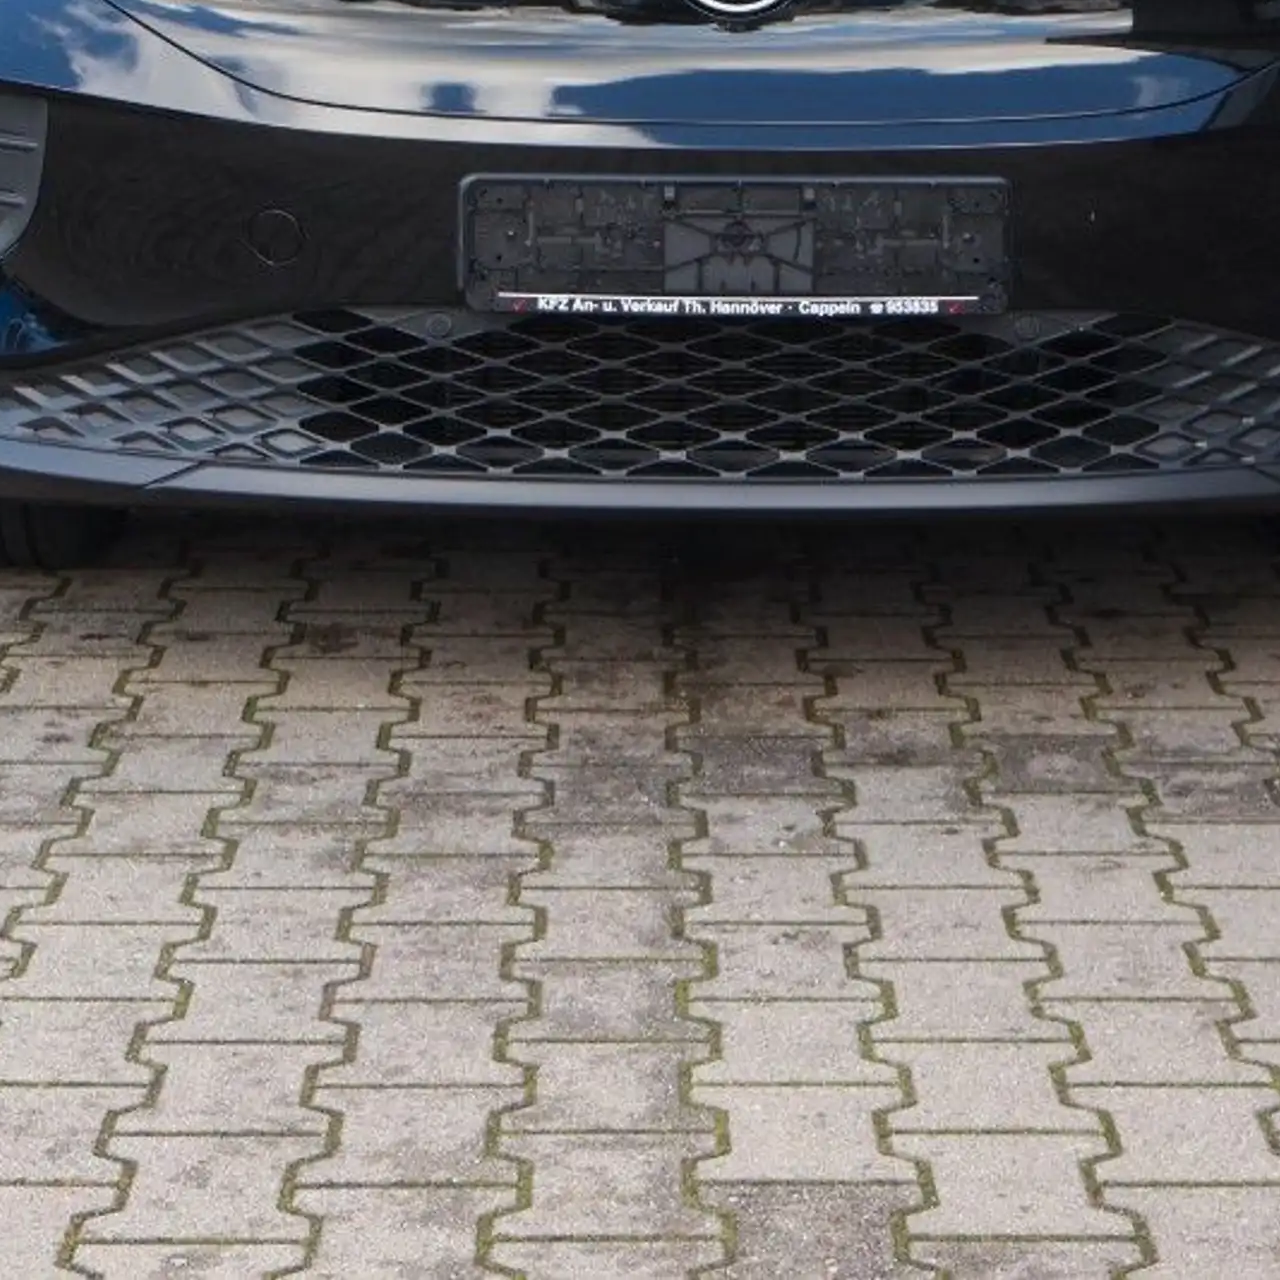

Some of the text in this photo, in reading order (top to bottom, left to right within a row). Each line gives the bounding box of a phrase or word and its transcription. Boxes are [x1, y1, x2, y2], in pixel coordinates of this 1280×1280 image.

[536, 297, 569, 311] KFZ
[572, 298, 598, 312] An-
[601, 300, 617, 313] u.
[620, 298, 680, 313] Verkauf
[682, 299, 706, 314] Th.
